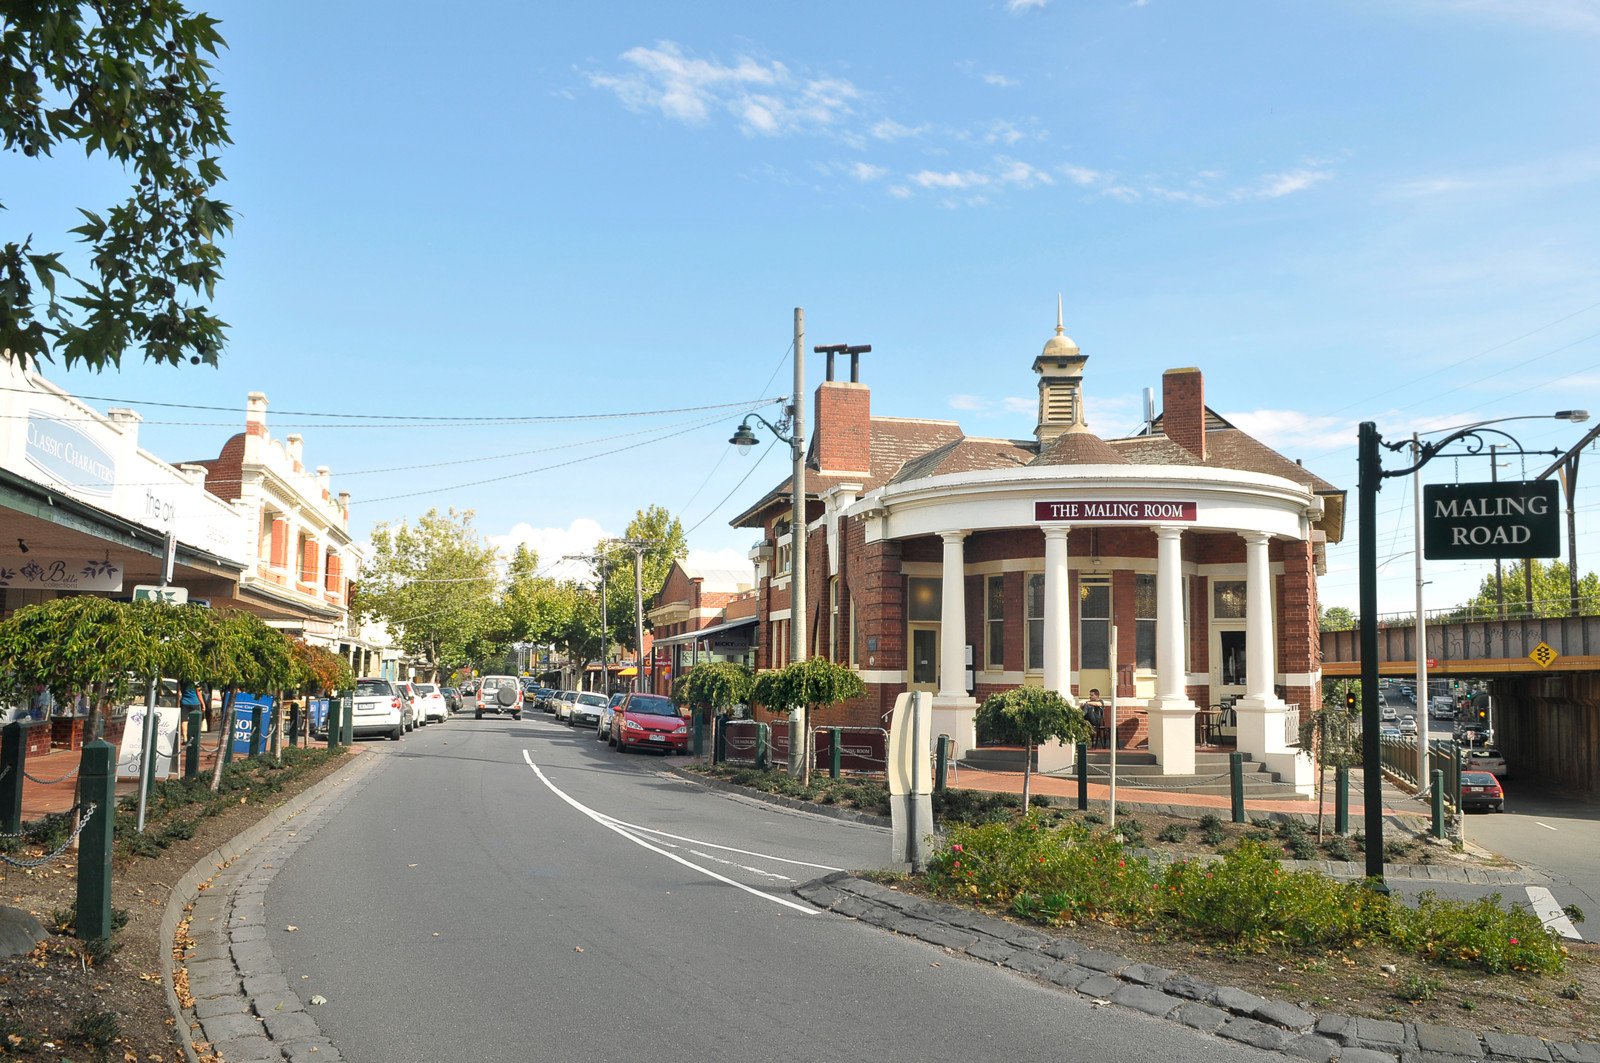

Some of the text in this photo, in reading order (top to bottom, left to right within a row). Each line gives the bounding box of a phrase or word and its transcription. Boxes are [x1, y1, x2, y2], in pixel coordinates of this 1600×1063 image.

[1050, 503, 1183, 518] THE MALING ROOM
[1434, 495, 1548, 518] MALING
[1451, 525, 1531, 546] ROAD
